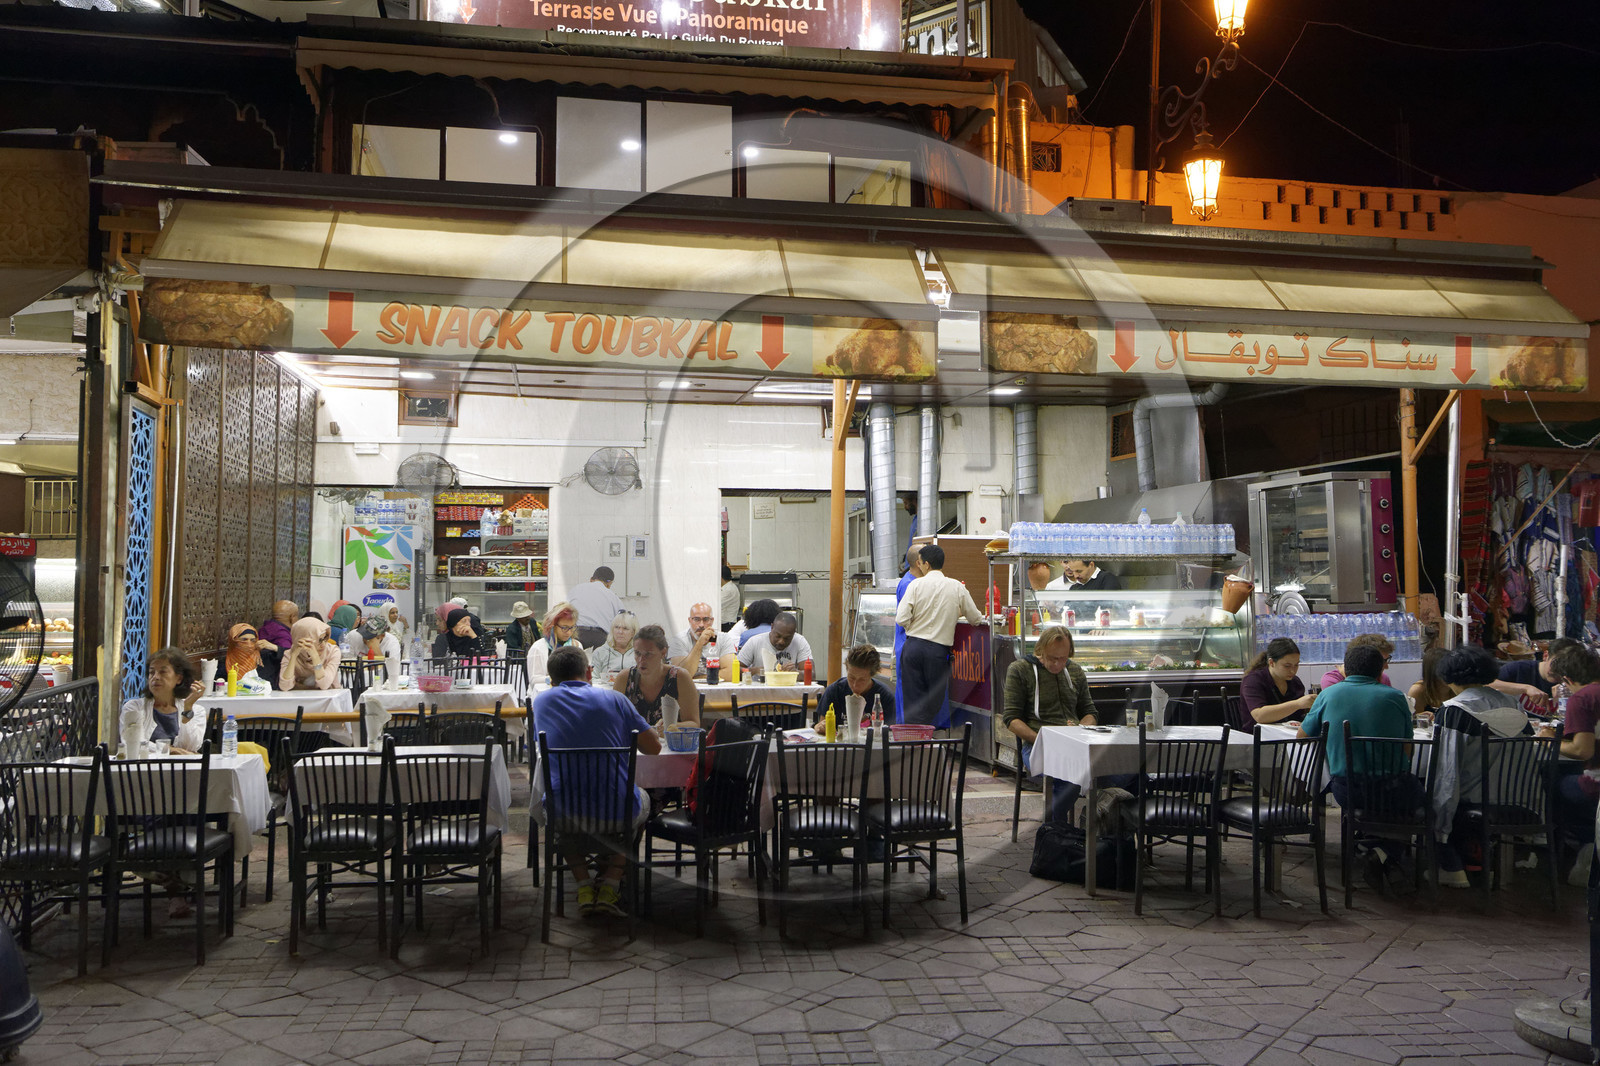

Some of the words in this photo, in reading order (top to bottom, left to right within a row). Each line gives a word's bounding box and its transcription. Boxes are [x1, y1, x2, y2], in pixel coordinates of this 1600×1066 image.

[530, 0, 615, 21] Terrasse
[619, 3, 658, 24] Vue
[677, 9, 809, 37] Panoramique
[376, 301, 531, 351] SNACK
[545, 311, 738, 361] TOUBKAL
[1155, 326, 1310, 376] توبقال
[1318, 335, 1438, 372] سناك
